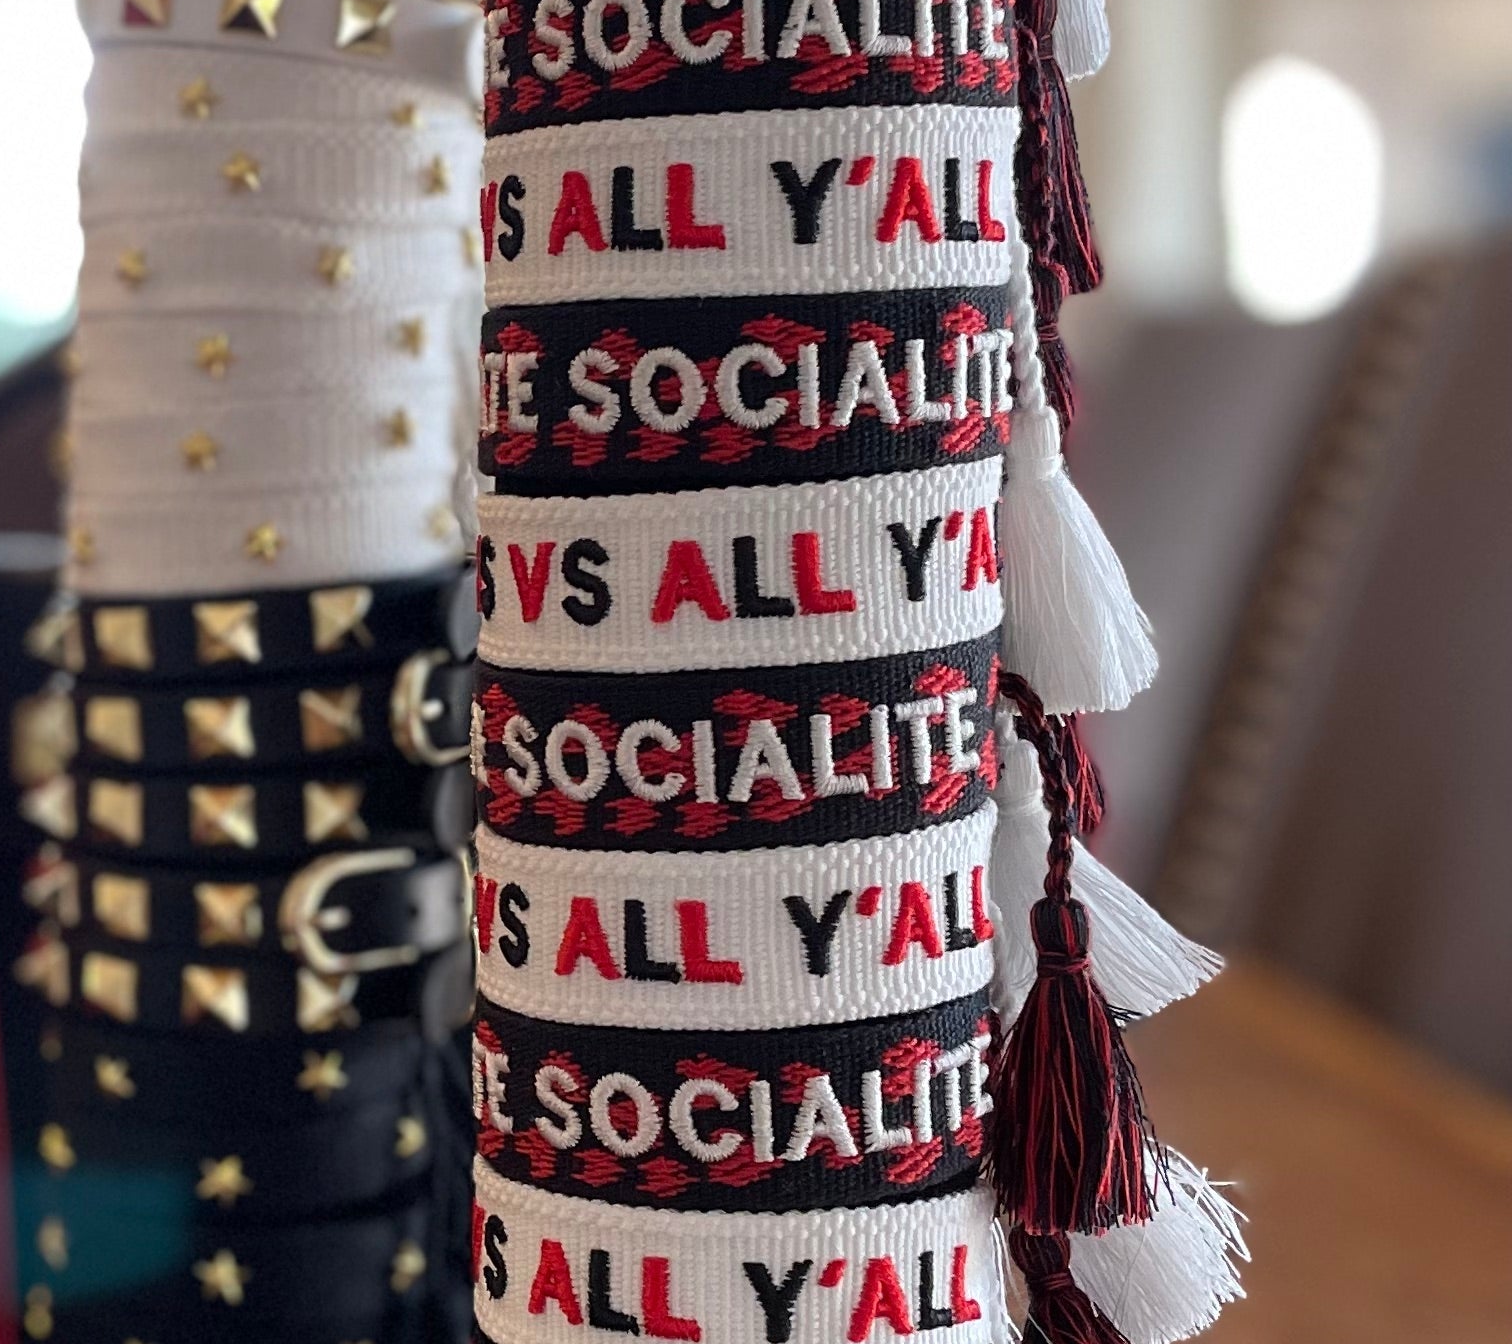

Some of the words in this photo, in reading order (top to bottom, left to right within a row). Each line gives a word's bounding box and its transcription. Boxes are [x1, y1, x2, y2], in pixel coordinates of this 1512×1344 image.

[548, 162, 727, 255] ALL
[769, 155, 1006, 244] Y'ALL
[508, 538, 612, 626] VS
[651, 532, 857, 625] ALL
[887, 507, 1000, 601] Y'A
[502, 687, 980, 803] SOCIALITE
[554, 896, 743, 985] ALL
[783, 865, 994, 977] Y'ALL
[528, 1238, 702, 1343] ALL
[743, 1244, 982, 1344] Y'ALL
